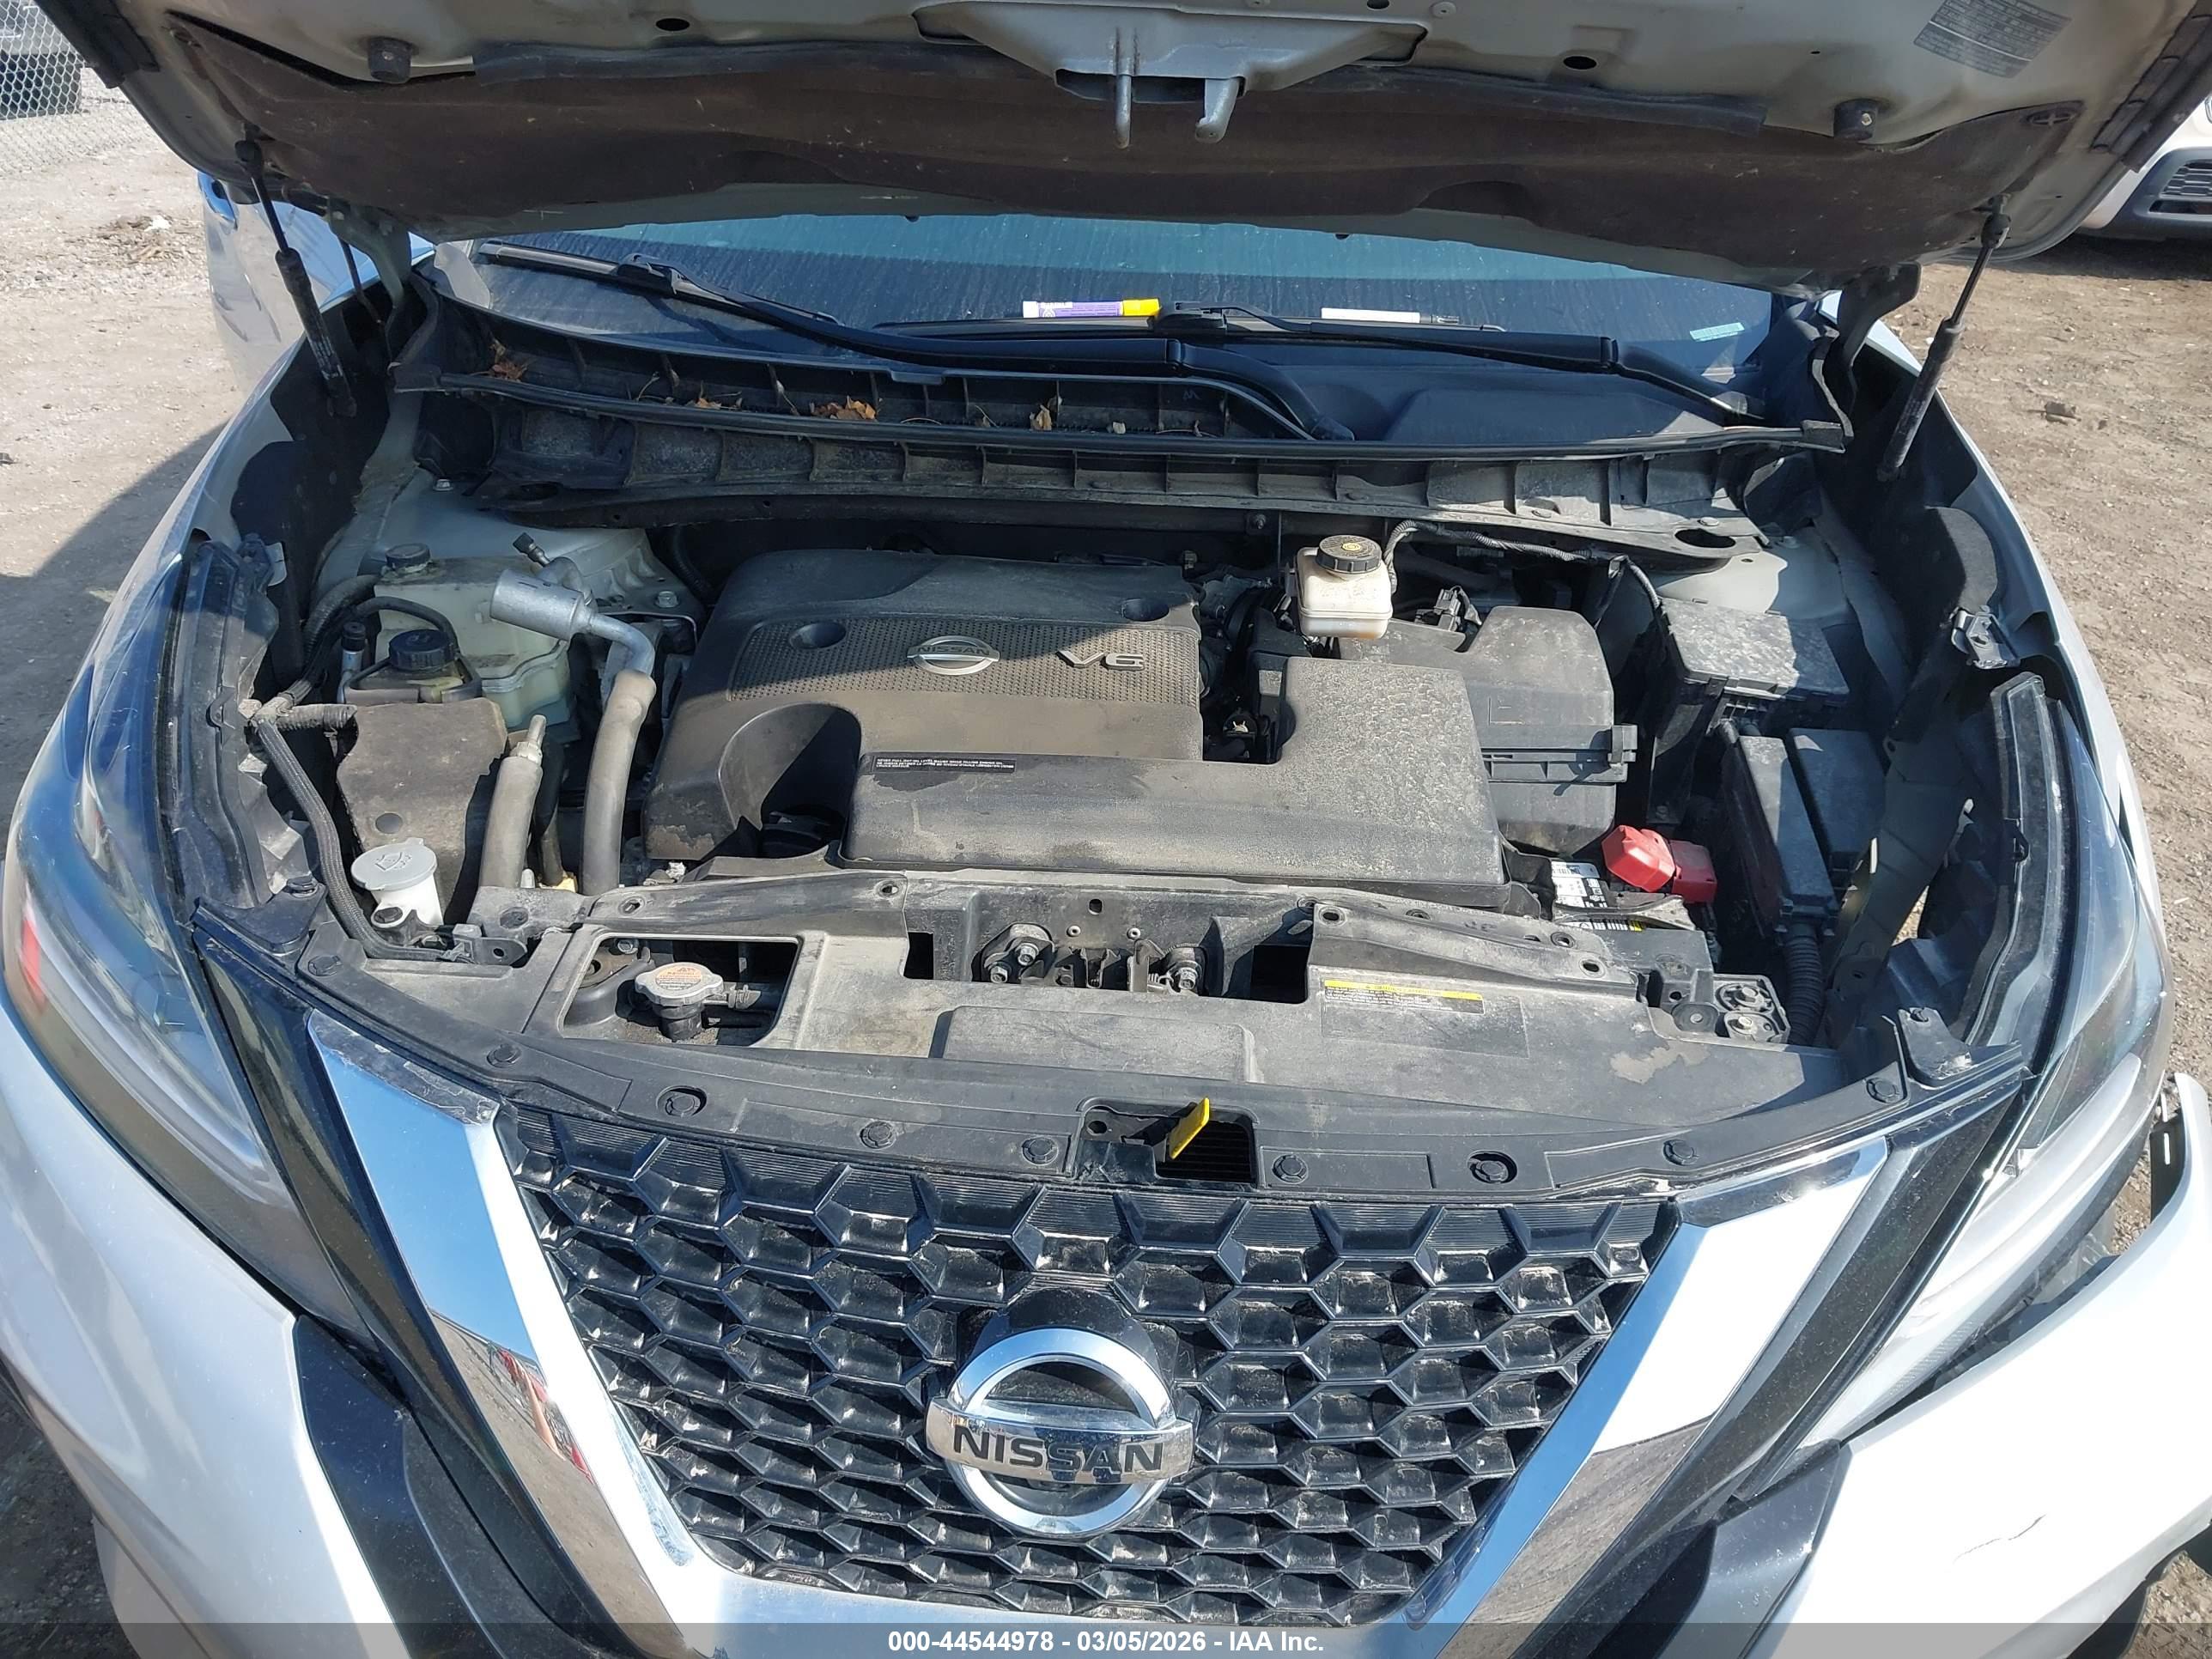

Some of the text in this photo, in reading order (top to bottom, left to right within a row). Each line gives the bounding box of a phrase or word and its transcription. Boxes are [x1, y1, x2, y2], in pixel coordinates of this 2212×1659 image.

[917, 646, 990, 656] NISSAN
[1056, 650, 1145, 671] V6
[953, 1425, 1164, 1474] NISSAN
